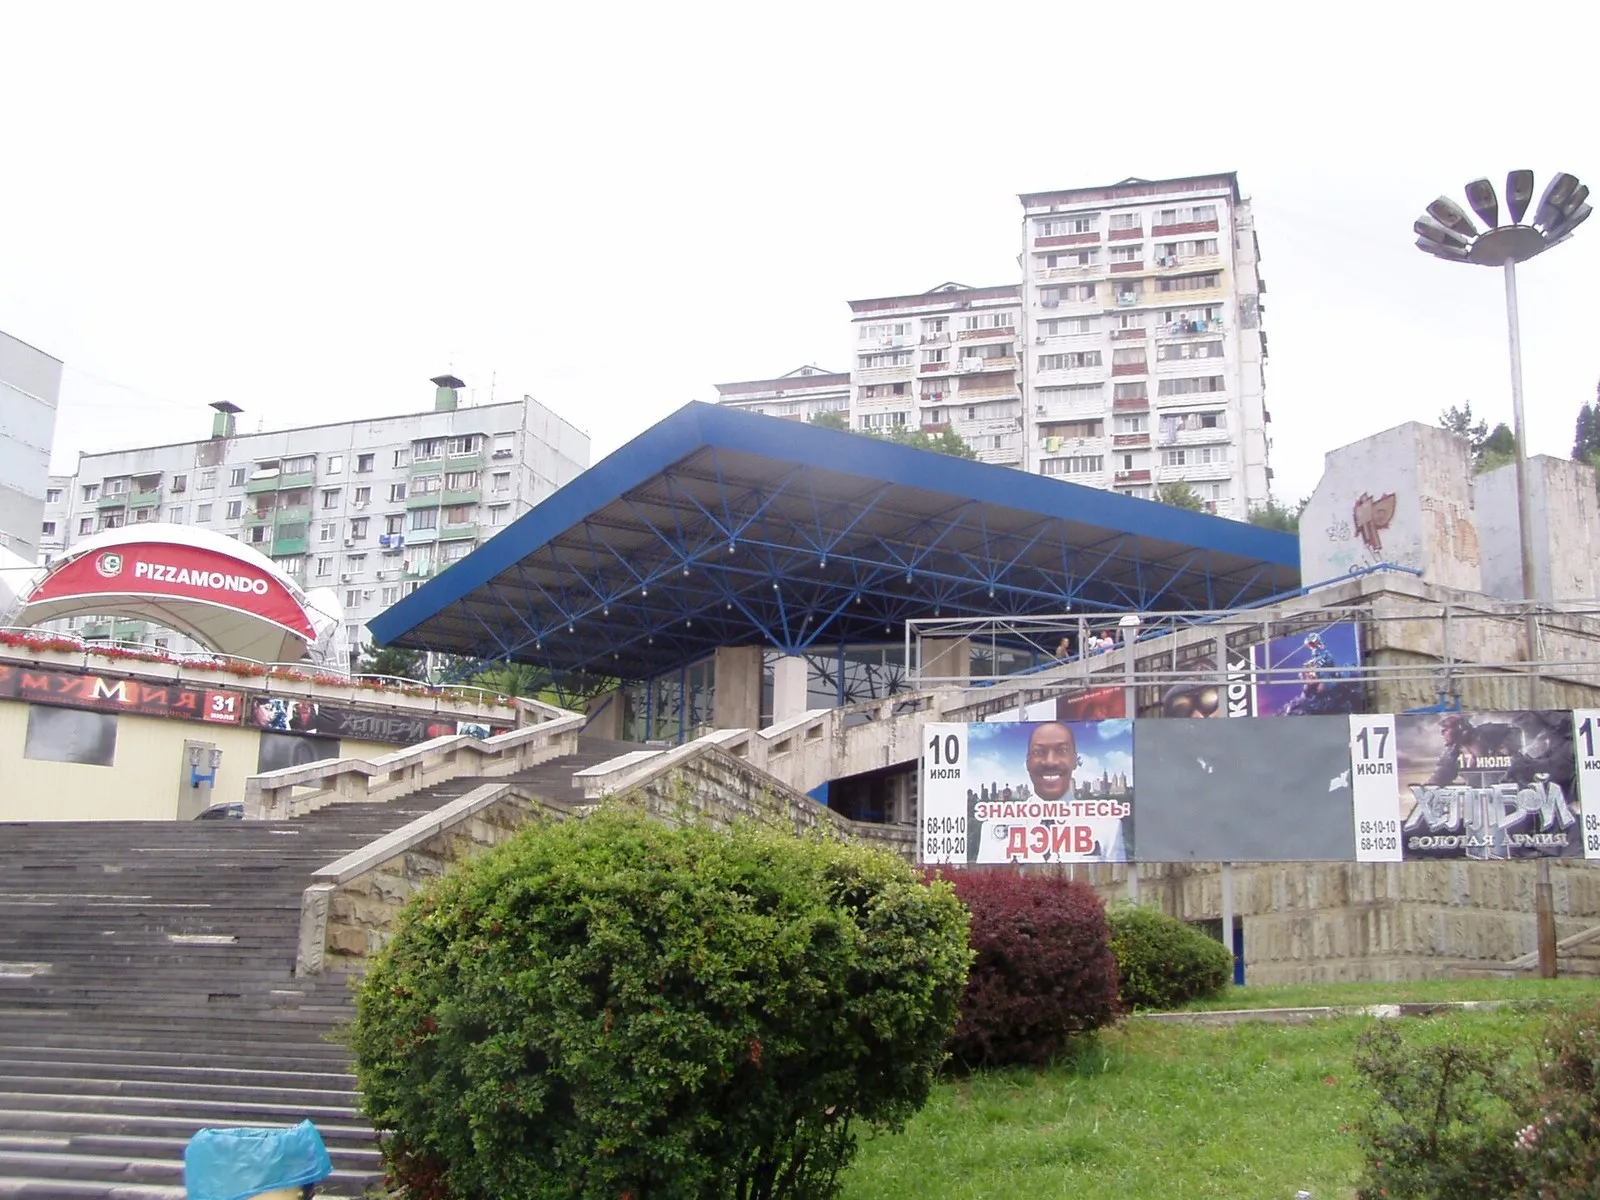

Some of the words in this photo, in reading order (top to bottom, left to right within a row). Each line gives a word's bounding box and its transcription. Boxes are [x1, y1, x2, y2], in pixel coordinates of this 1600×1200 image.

[135, 561, 269, 595] PIZZAMONDO
[211, 695, 235, 713] 31
[1356, 726, 1390, 760] 17
[1579, 717, 1600, 757] 1
[929, 734, 960, 765] 10
[1457, 754, 1472, 769] 17
[976, 802, 1130, 820] ЗНАКОМЬТЕСЬ:
[927, 816, 966, 834] 68-10-10
[1360, 820, 1396, 834] 68-10-10
[926, 836, 966, 855] 68-10-20
[1006, 820, 1094, 859] ДЭЙВ
[1360, 837, 1397, 851] 68-10-20
[1408, 834, 1494, 849] ЗОЛОТАЯ
[1501, 832, 1569, 848] АРМИЯ
